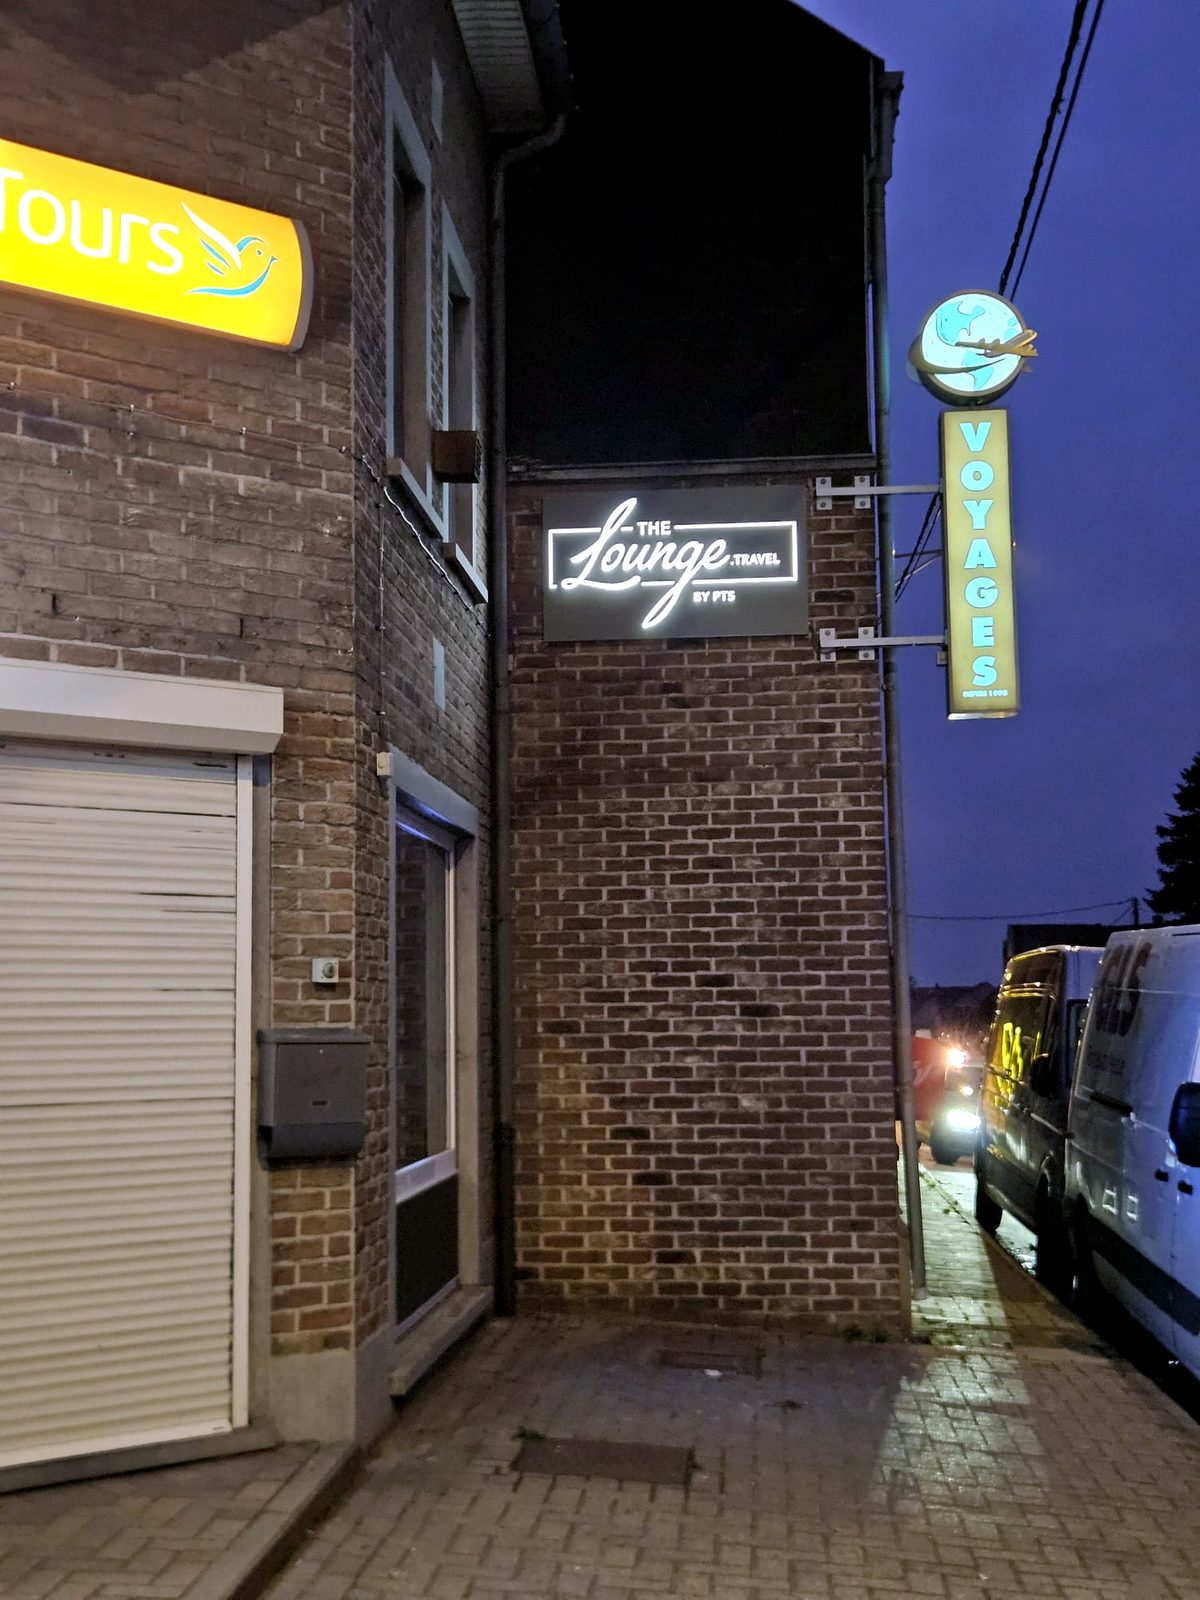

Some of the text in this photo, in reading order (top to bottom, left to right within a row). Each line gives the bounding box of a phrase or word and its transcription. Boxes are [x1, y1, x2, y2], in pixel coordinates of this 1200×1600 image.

[0, 166, 184, 275] Tours
[561, 497, 731, 630] Lounge
[635, 520, 673, 537] THE
[959, 421, 999, 688] VOYAGES
[692, 590, 736, 603] BY PTS
